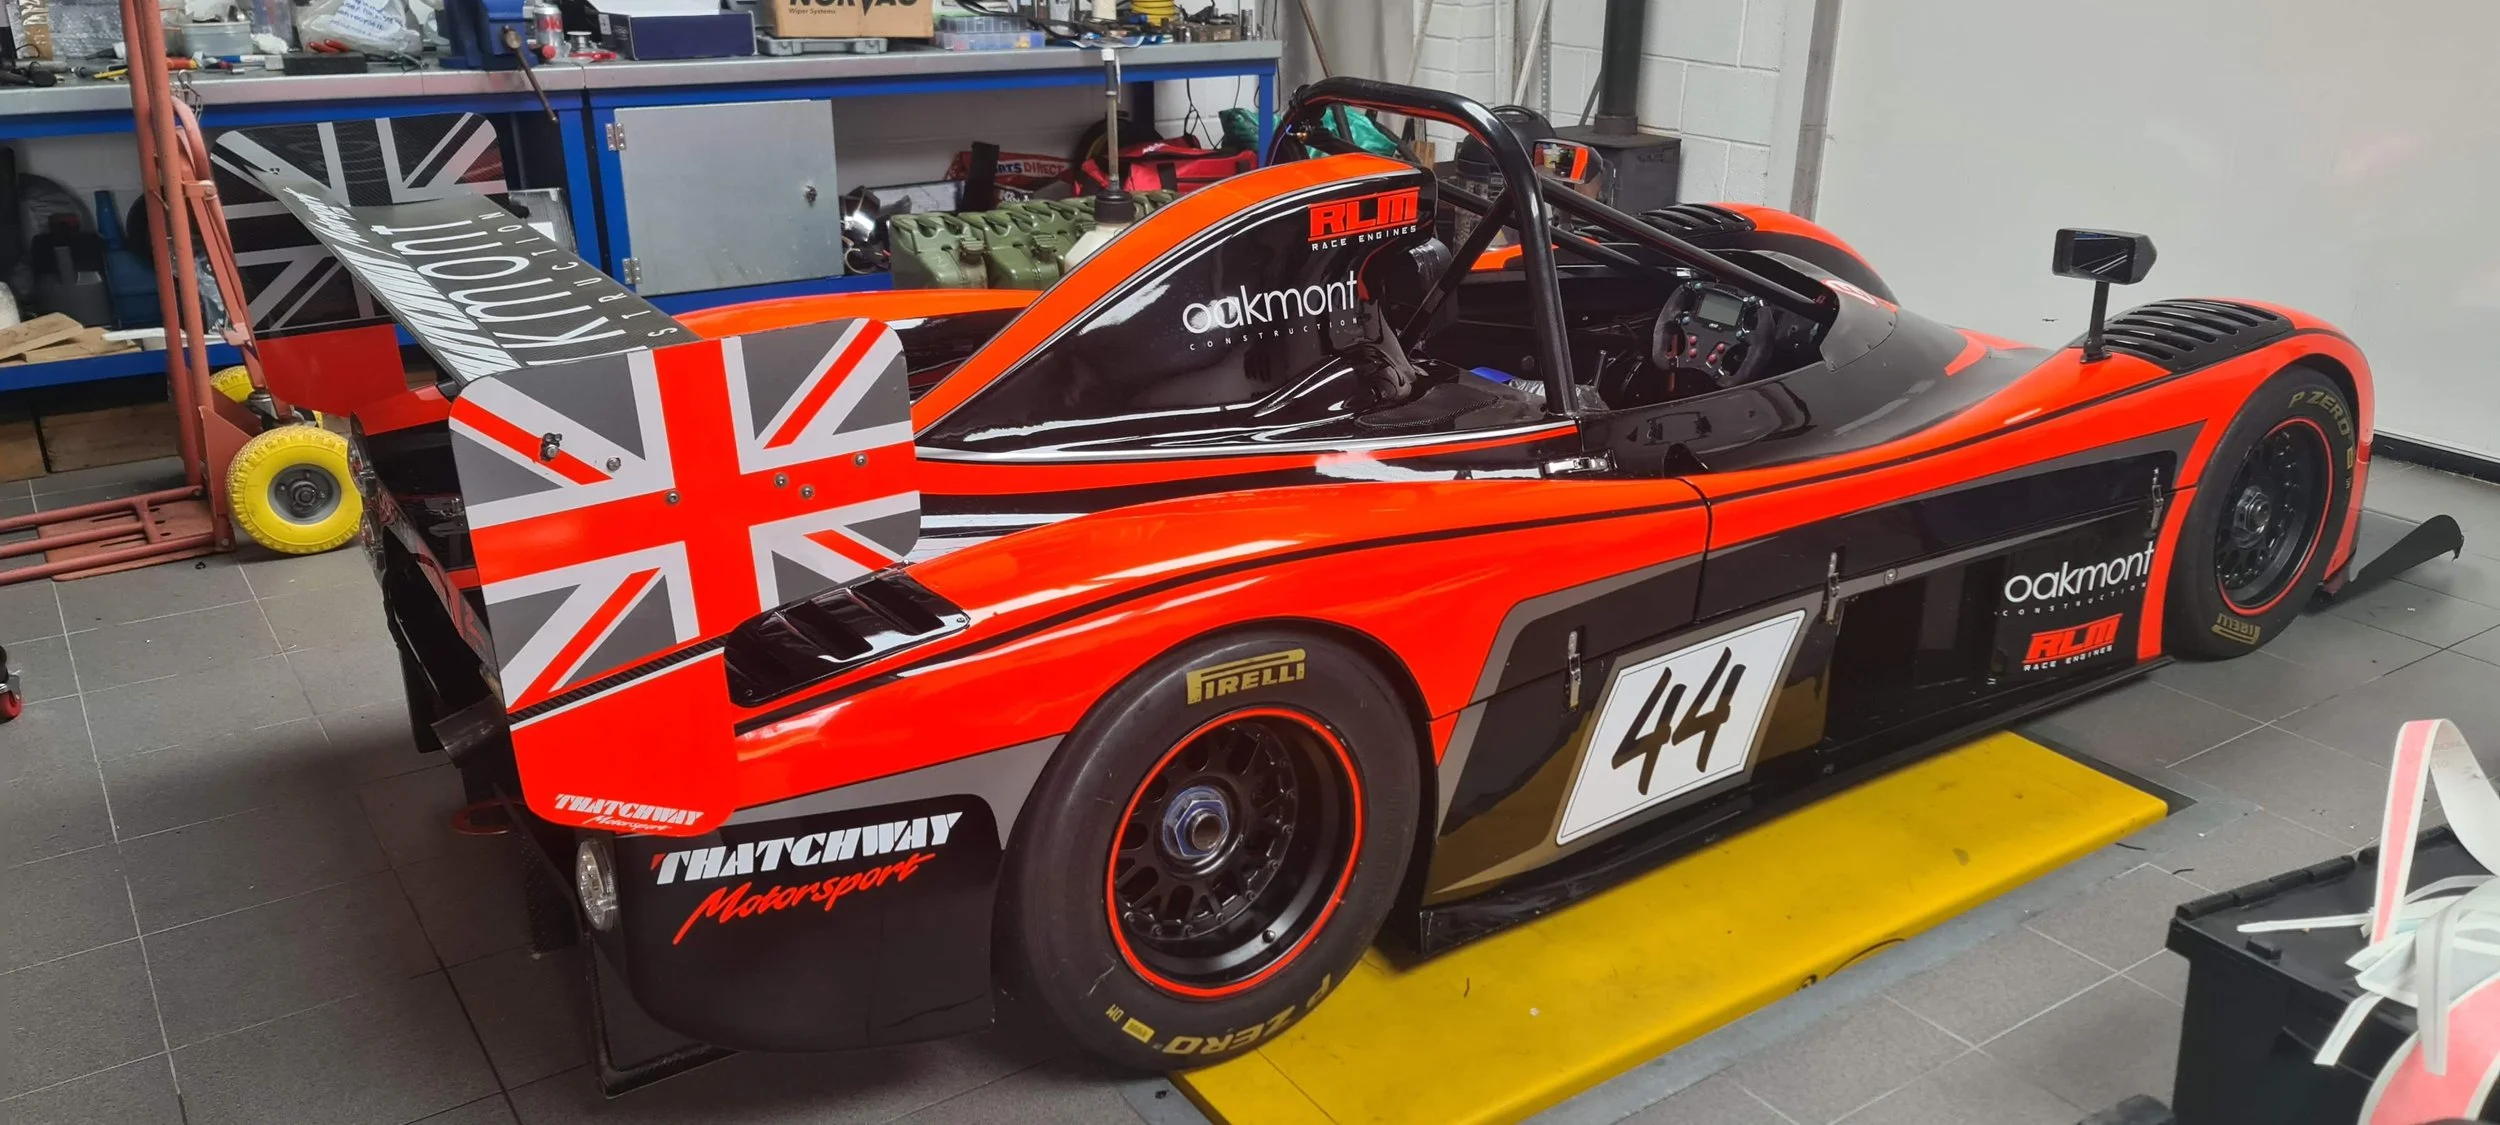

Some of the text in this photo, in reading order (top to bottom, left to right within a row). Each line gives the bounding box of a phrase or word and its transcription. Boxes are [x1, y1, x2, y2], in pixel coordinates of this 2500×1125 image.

[1023, 162, 1065, 175] DIRECT
[1309, 189, 1419, 239] RLM
[1311, 224, 1417, 252] RACE ENGINES
[1182, 270, 1358, 334] oakmont
[1189, 317, 1358, 351] CONSTRUCTION
[2287, 390, 2351, 436] P ZERO
[2003, 540, 2155, 603] oakmont
[2023, 614, 2122, 662] RLM
[2210, 612, 2261, 646] PIRELLI
[1186, 647, 1306, 705] PIRELLI
[2023, 645, 2113, 672] RACE ENGINES
[1611, 646, 1747, 796] 44
[554, 793, 705, 826] THATCHWAY
[581, 815, 673, 832] Motorsport
[650, 811, 963, 886] THATCHWAY
[671, 852, 936, 946] Motorsport
[1162, 1005, 1296, 1055] ZERO
